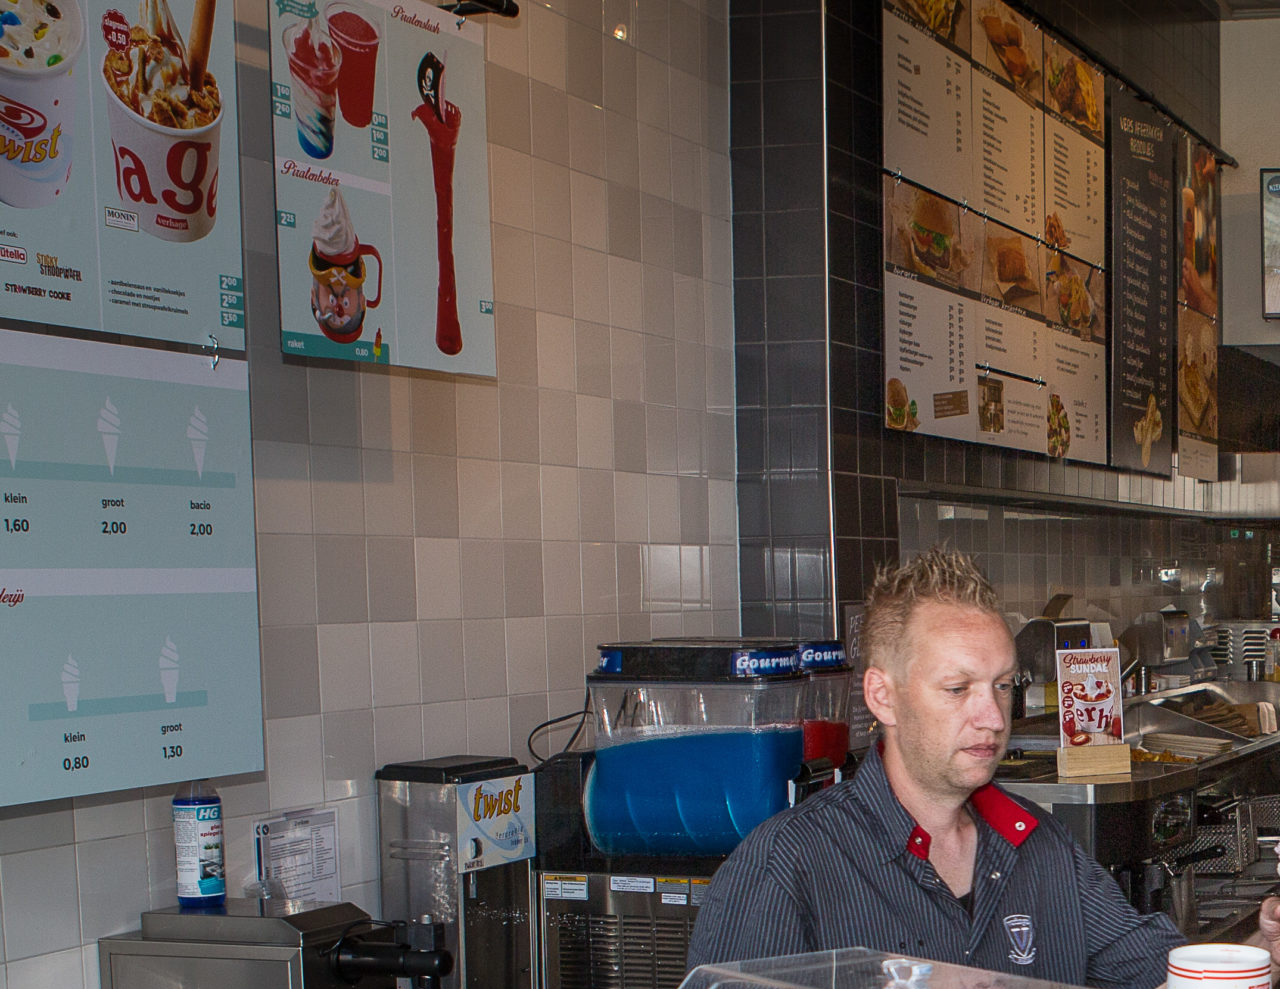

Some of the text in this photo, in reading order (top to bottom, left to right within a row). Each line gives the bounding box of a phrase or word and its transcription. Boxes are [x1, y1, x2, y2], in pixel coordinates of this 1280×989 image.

[390, 4, 440, 34] Piratenslush
[0, 123, 61, 163] wist
[280, 159, 340, 187] Piratenbeker
[107, 209, 136, 222] MONIN
[0, 247, 25, 261] utella
[49, 290, 71, 301] COOKIE
[287, 339, 304, 349] raket
[4, 493, 27, 504] klein
[102, 498, 124, 508] groot
[190, 500, 210, 510] bacio
[4, 519, 29, 533] 1,60
[102, 521, 127, 535] 2,00
[190, 523, 213, 536] 2,00
[1063, 653, 1112, 668] Strawberry
[1070, 664, 1108, 673] SUNDAE
[161, 722, 183, 736] groot
[64, 731, 86, 744] klein
[162, 745, 183, 760] 1,30
[63, 755, 89, 772] 0,80
[473, 776, 522, 821] twist
[199, 807, 218, 820] HG
